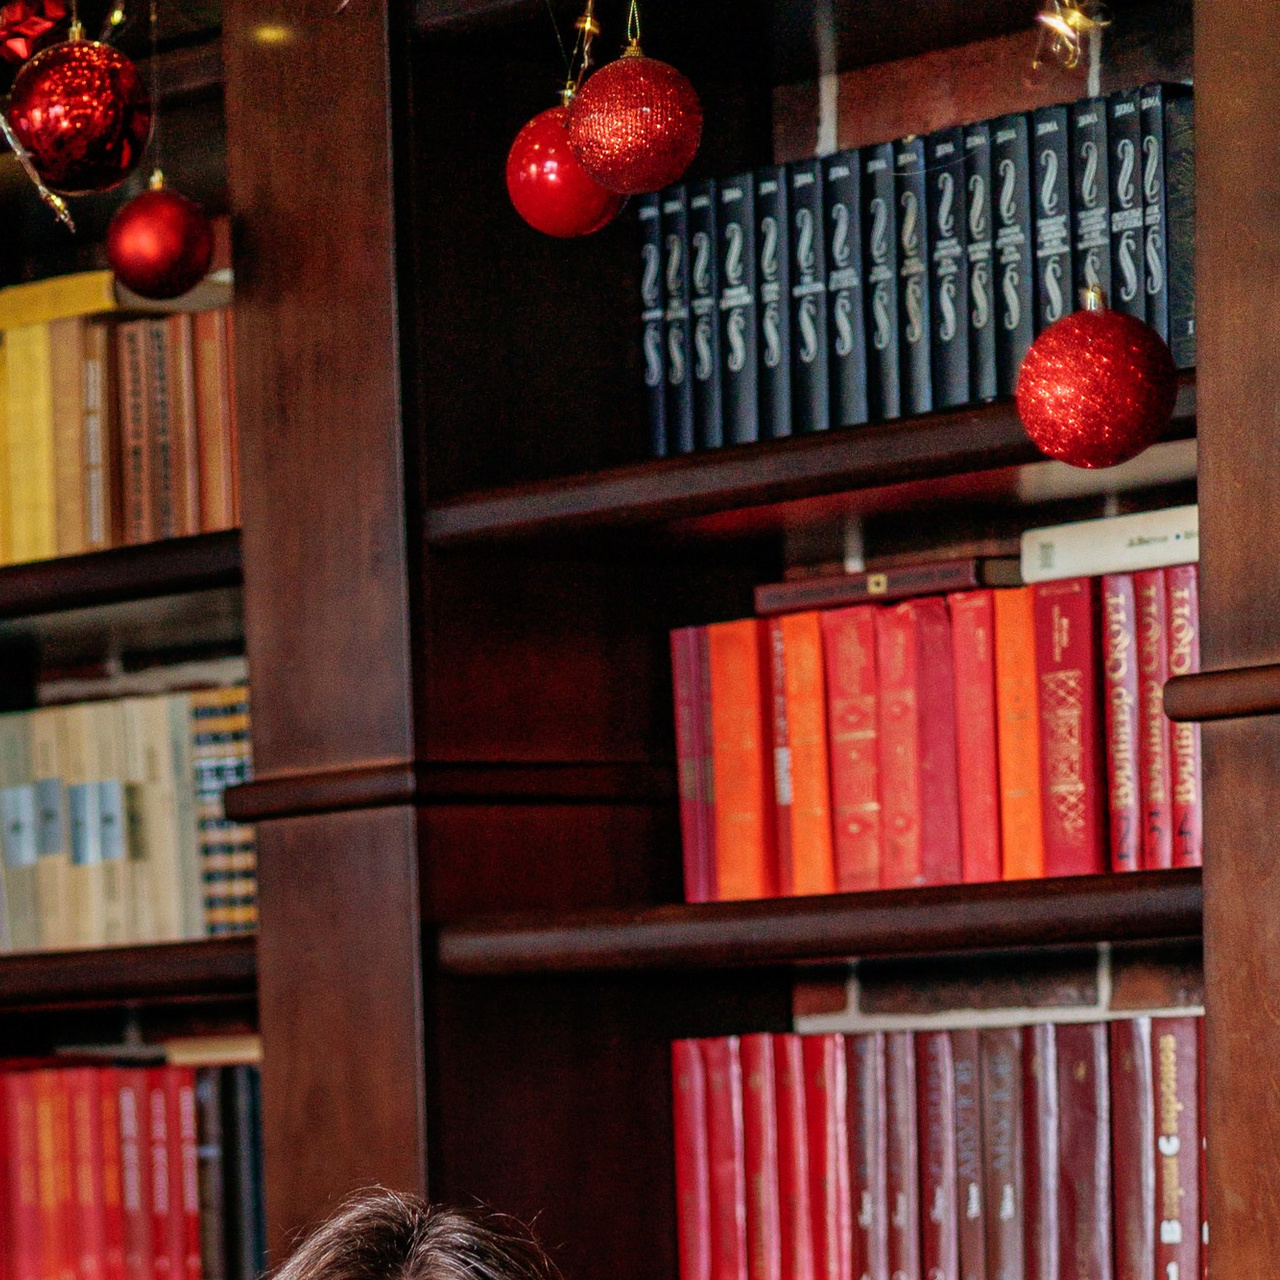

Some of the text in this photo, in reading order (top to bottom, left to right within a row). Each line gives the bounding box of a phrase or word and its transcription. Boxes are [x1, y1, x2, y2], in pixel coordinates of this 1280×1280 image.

[1105, 592, 1131, 680] Скотт
[1170, 587, 1195, 676] Скотт
[1110, 685, 1135, 810] Вальтер
